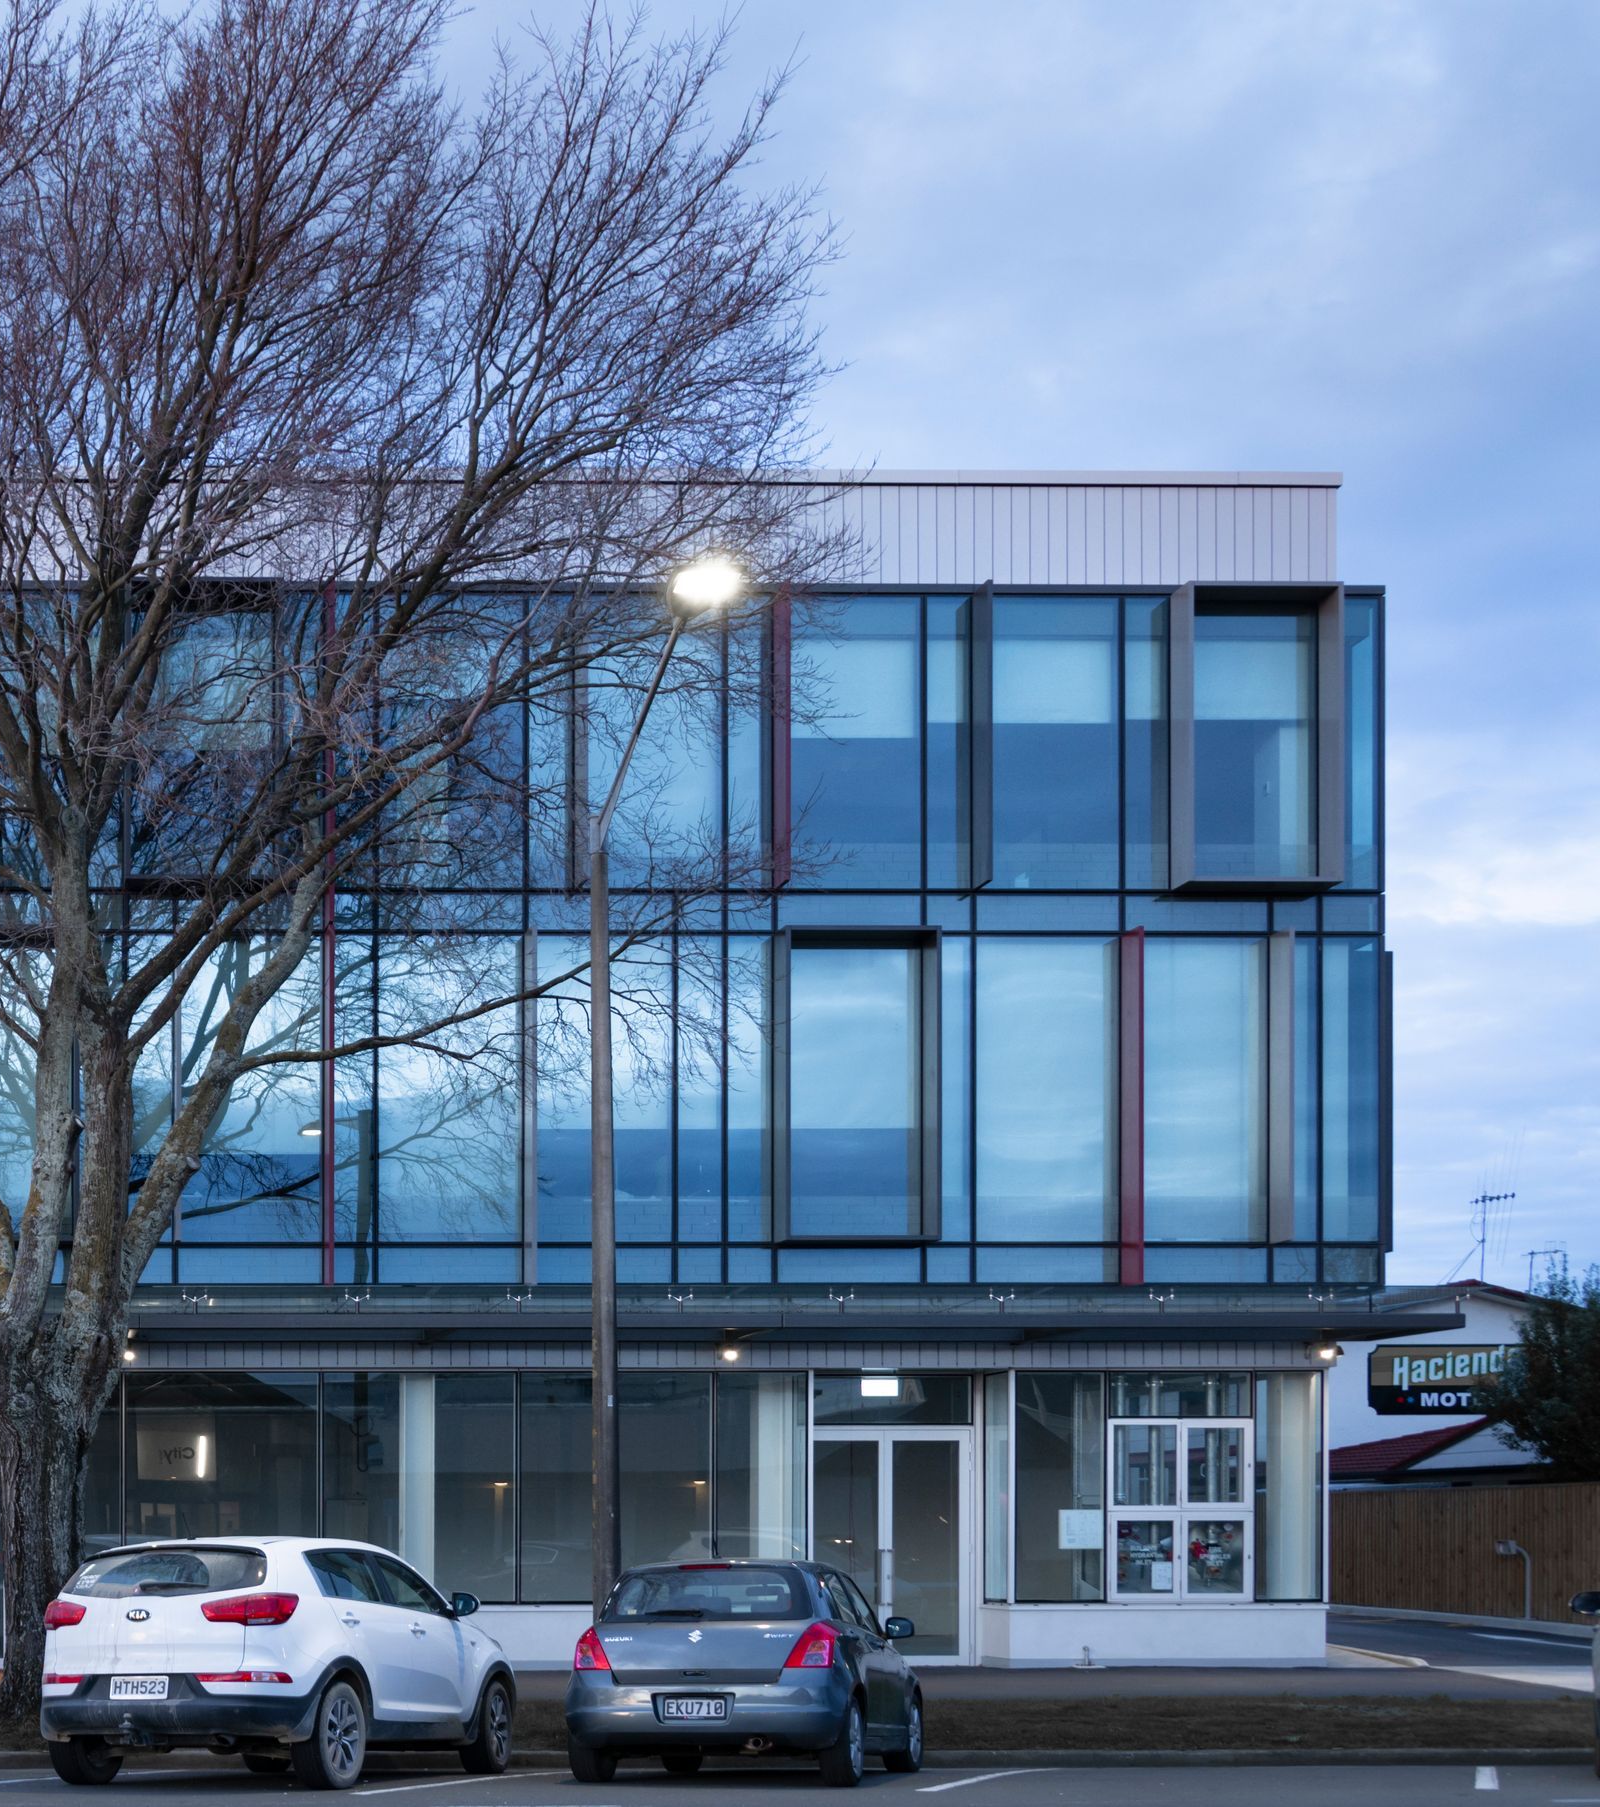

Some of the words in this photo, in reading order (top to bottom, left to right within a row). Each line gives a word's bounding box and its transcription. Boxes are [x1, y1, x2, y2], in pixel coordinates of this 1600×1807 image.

[1420, 1392, 1481, 1407] MOT
[129, 1610, 147, 1619] KIA
[113, 1680, 167, 1695] HTH523
[666, 1701, 723, 1715] EKU710
